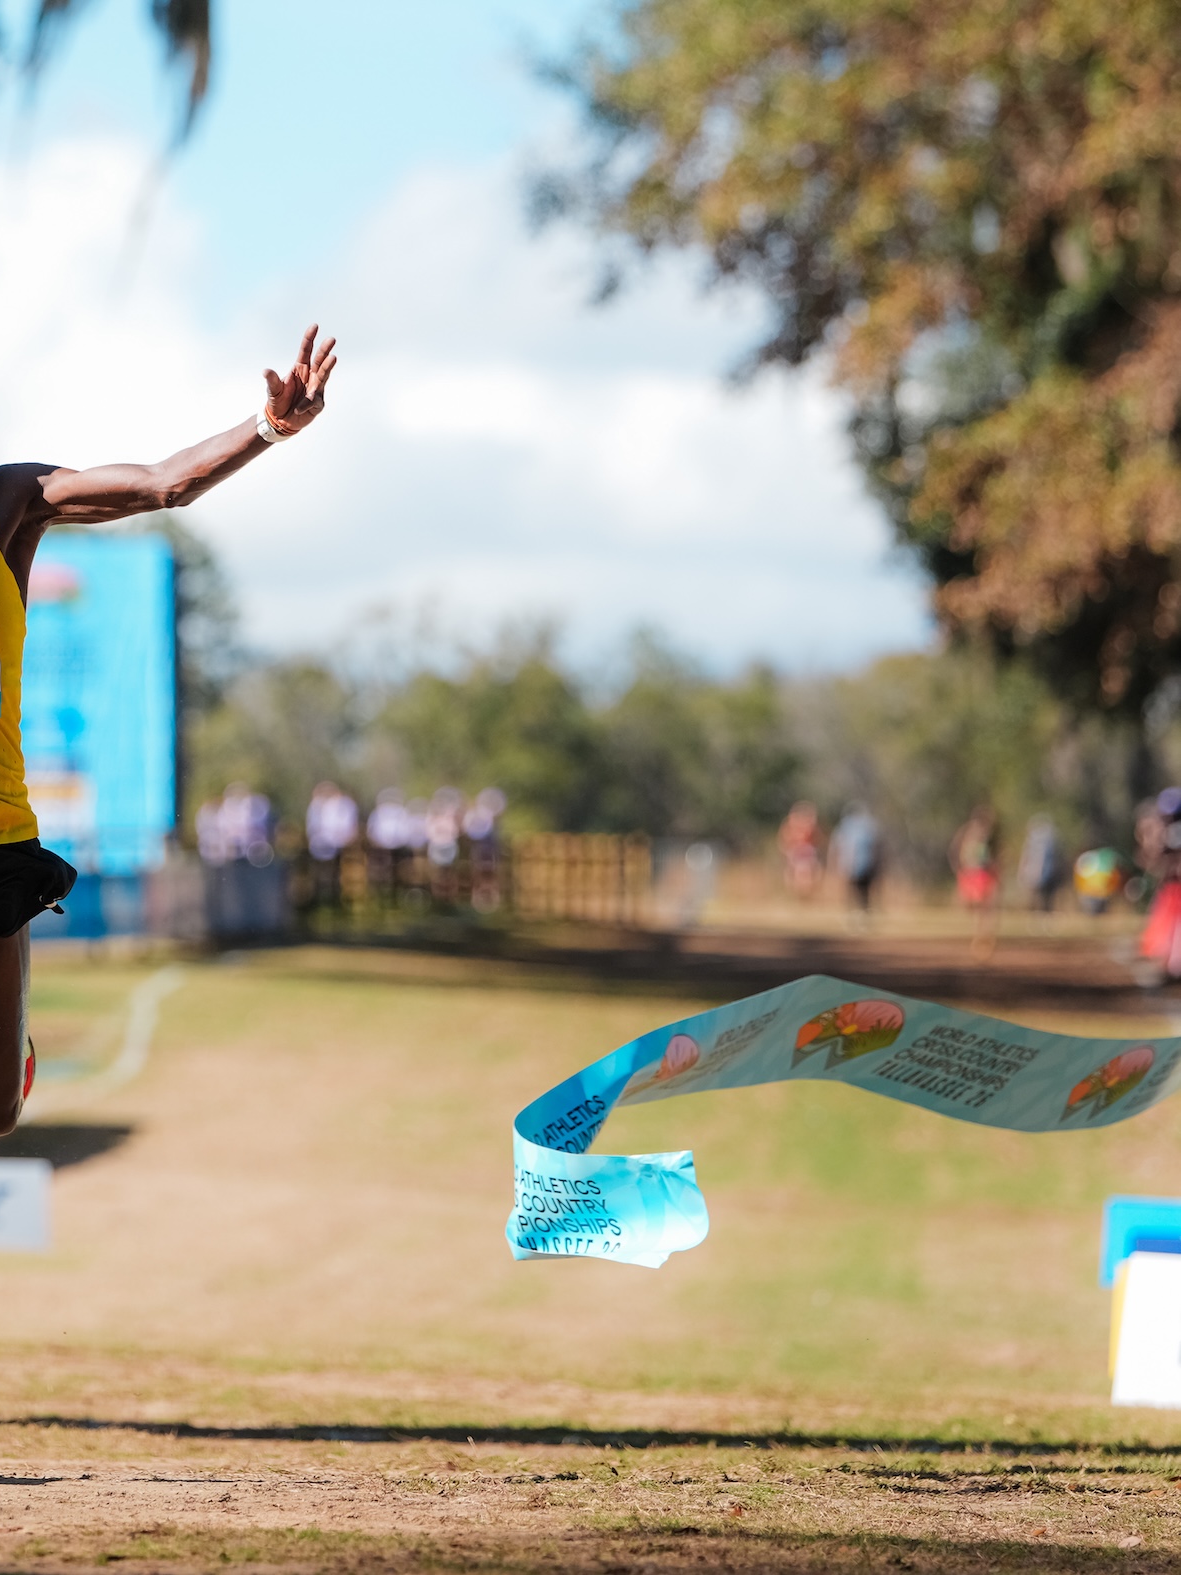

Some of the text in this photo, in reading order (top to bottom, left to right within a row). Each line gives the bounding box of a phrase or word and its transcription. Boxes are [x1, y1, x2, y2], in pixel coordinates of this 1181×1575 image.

[912, 1036, 1027, 1075] CROSS COUNTRY
[930, 1025, 1040, 1062] WORLD ATHLETICS
[894, 1048, 1010, 1091] CHAMPIONSHIPS
[542, 1095, 606, 1146] ATHLETICS
[520, 1170, 601, 1195] ATHLETICS
[522, 1193, 609, 1215] COUNTRY
[516, 1214, 622, 1236] PIONSHIPS
